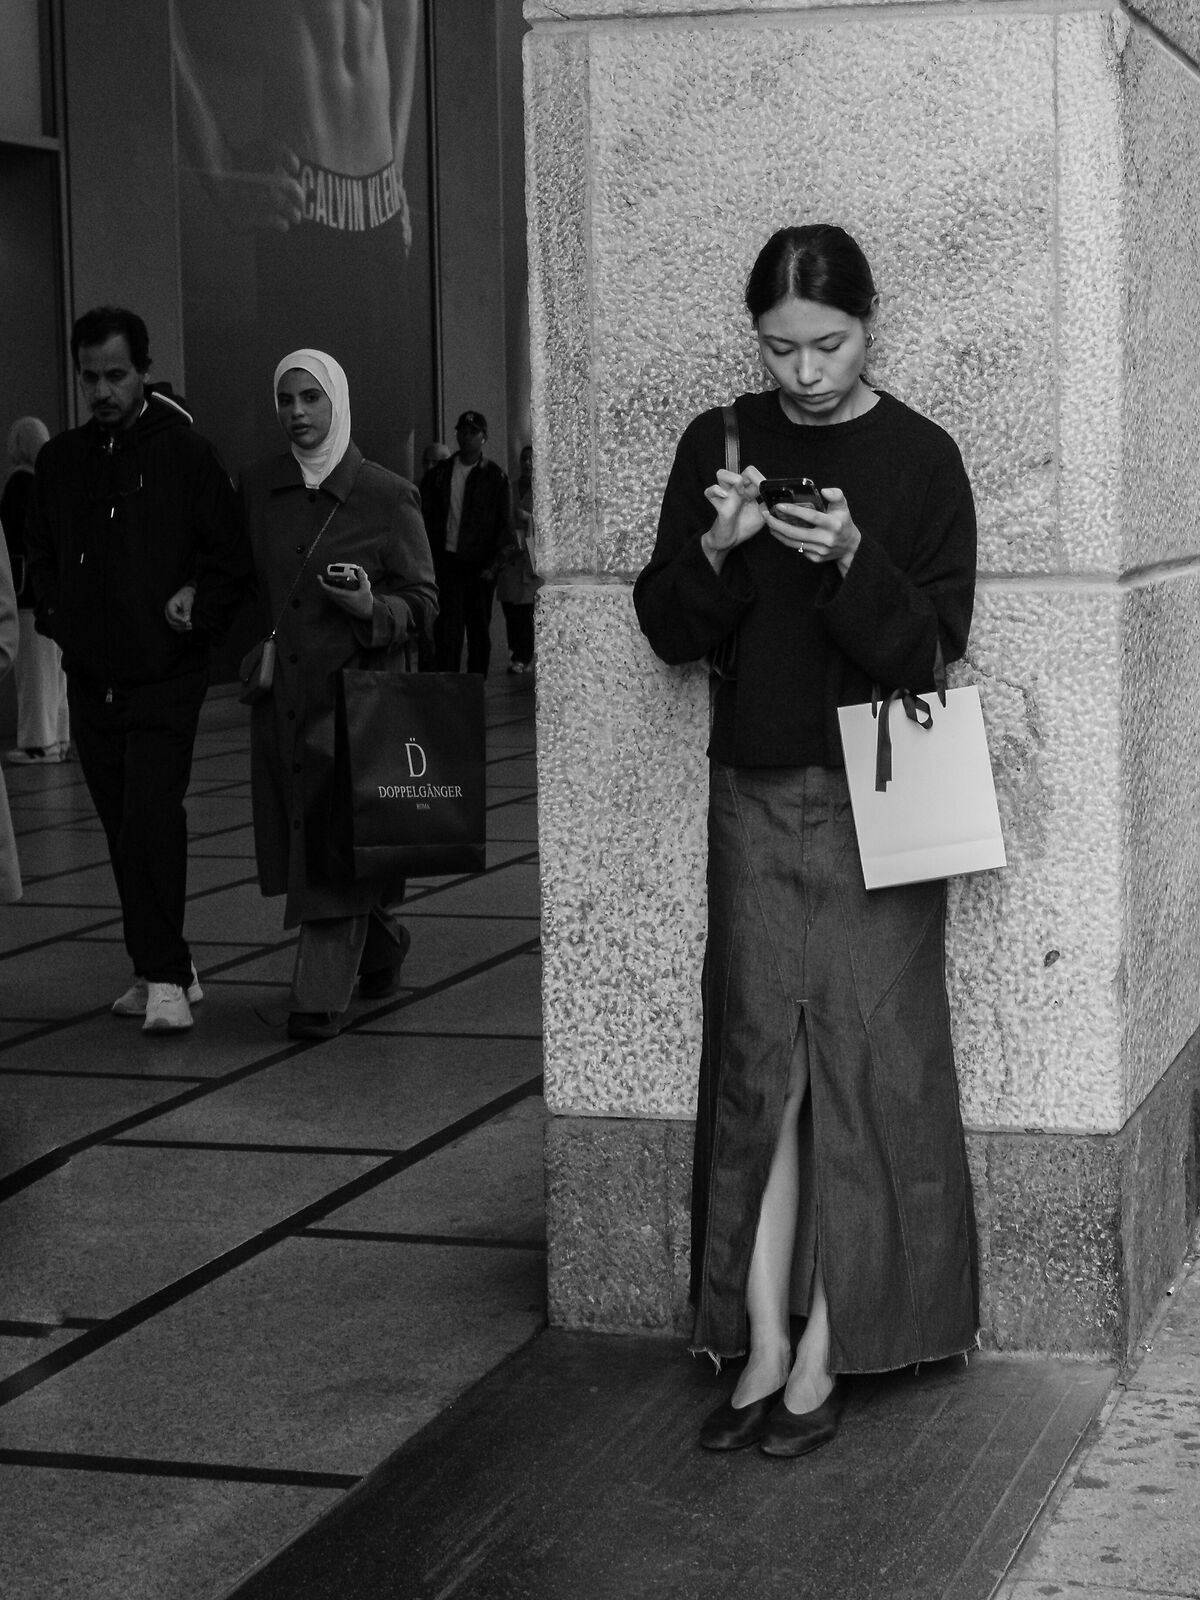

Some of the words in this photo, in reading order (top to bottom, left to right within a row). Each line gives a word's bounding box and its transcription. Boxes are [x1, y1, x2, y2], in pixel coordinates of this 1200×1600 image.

[301, 165, 365, 231] CALVIN
[368, 163, 401, 228] KLEIN
[378, 784, 463, 798] DOPPELGÄNGER
